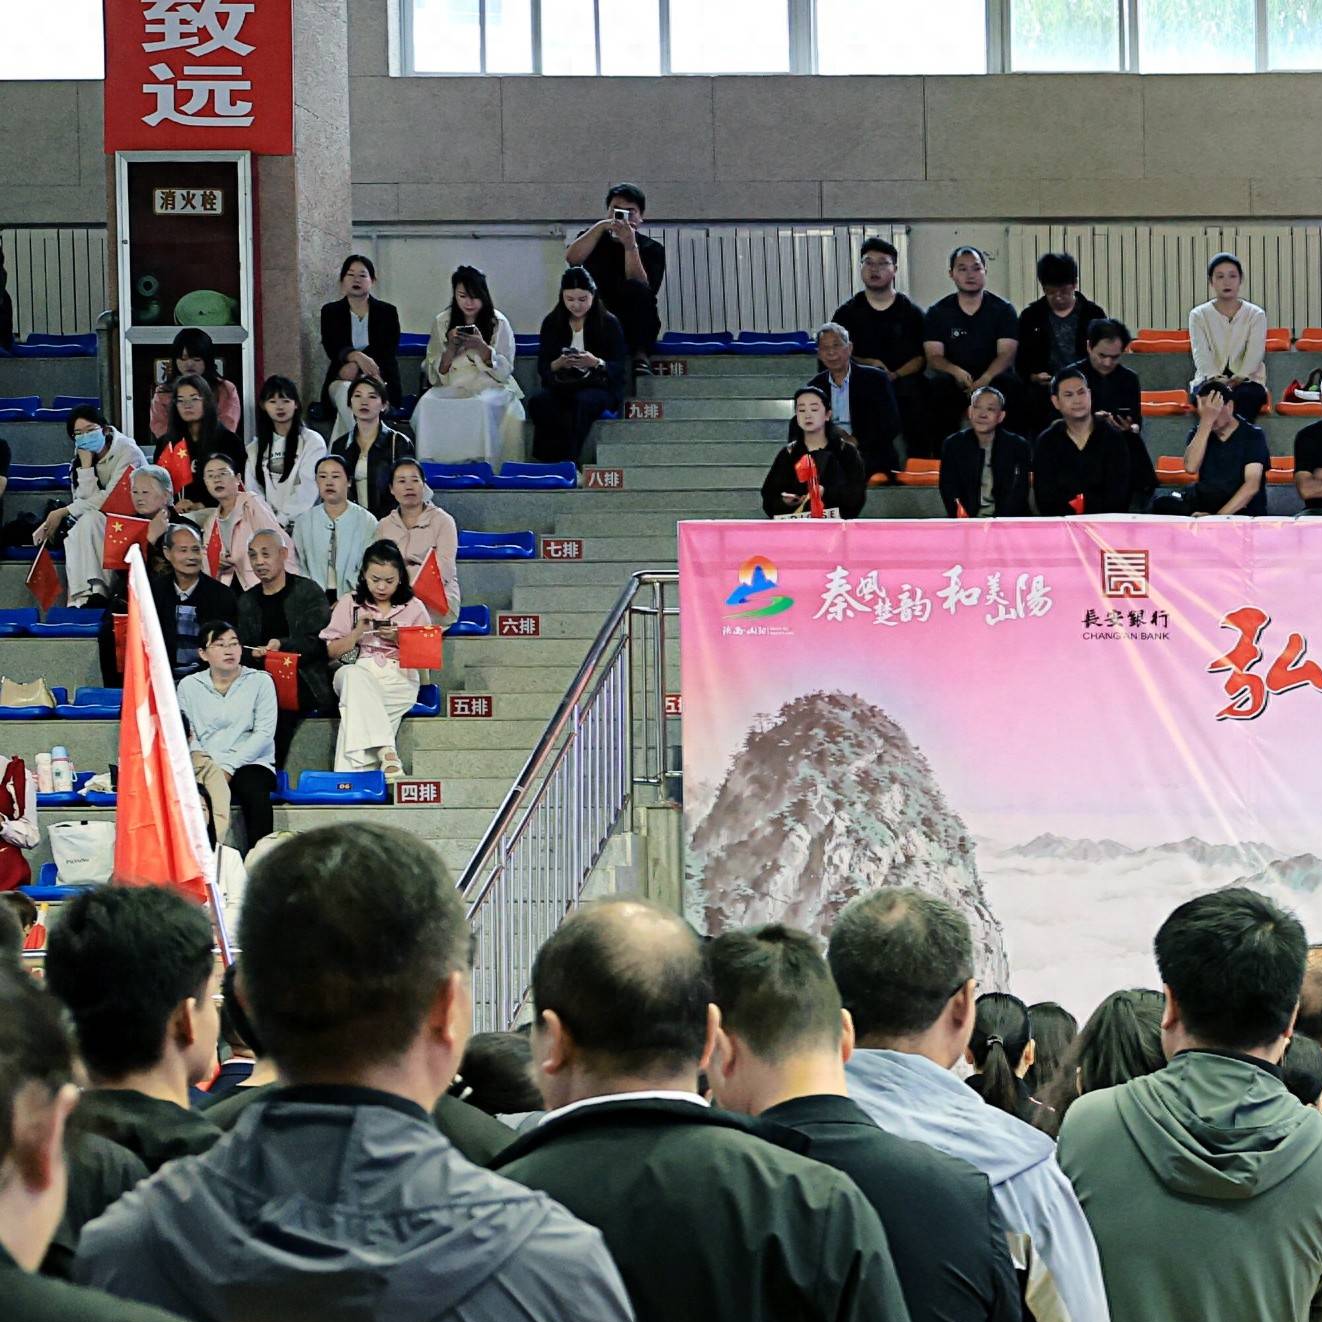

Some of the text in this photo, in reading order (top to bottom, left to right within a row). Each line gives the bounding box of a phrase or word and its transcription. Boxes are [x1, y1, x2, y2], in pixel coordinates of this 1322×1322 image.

[141, 0, 256, 127] 致远
[160, 190, 217, 211] 消火栓
[654, 361, 684, 376] 十排
[629, 403, 660, 419] 九排
[588, 471, 620, 487] 八排
[546, 541, 579, 558] 七排
[502, 617, 536, 635] 六排
[1141, 632, 1170, 640] BANK
[453, 698, 489, 716] 五排
[401, 783, 438, 801] 四排
